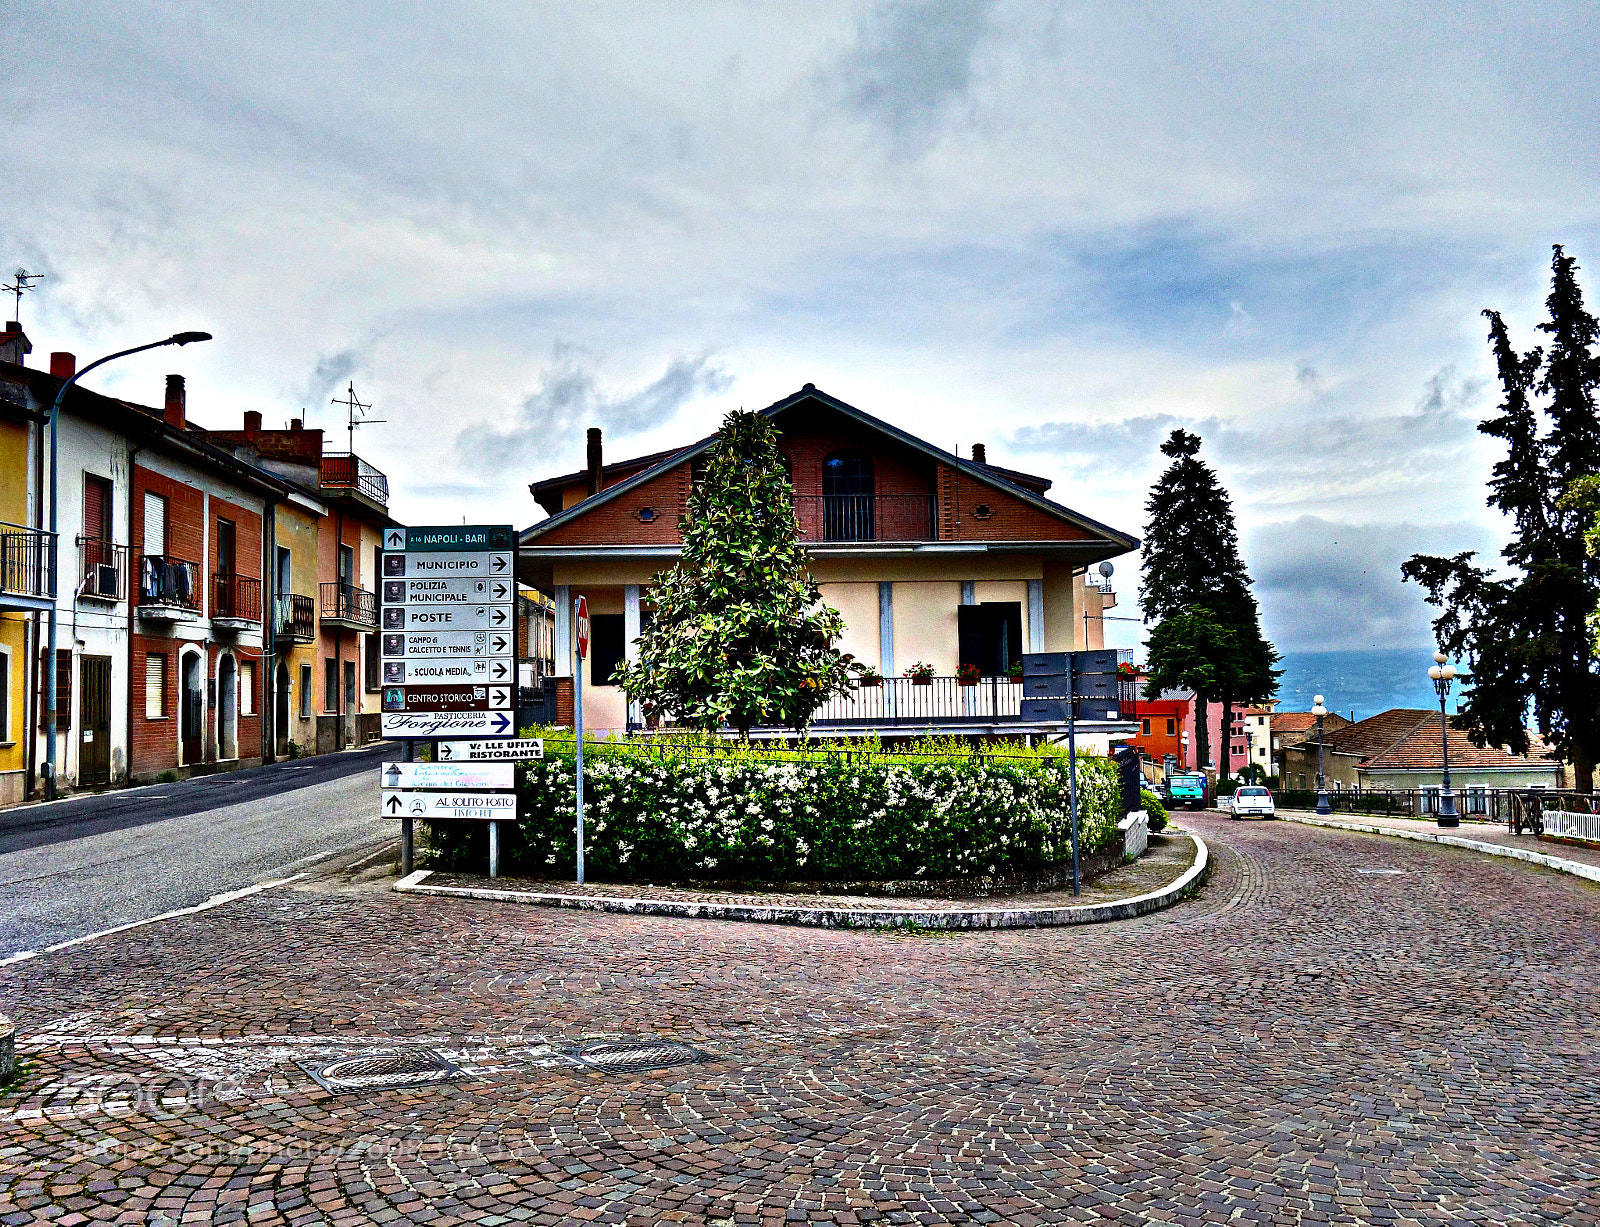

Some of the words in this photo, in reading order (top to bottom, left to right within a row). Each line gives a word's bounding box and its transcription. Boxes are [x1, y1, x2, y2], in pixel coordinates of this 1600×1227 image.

[424, 534, 458, 544] NAPOLI
[465, 534, 486, 543] BARI
[416, 561, 479, 570] MUNICIPIO
[410, 582, 448, 590] POLIZIA
[410, 594, 468, 602] MUNICIPALE
[411, 613, 452, 622] POSTE
[414, 668, 444, 676] SCUOLA
[445, 668, 468, 676] MEDIA
[407, 694, 438, 702] CENTRO
[440, 693, 473, 702] STORICO
[384, 714, 486, 735] Forgione
[470, 750, 542, 758] RISTORANTE
[436, 798, 449, 806] AL
[452, 798, 483, 806] SOLITO
